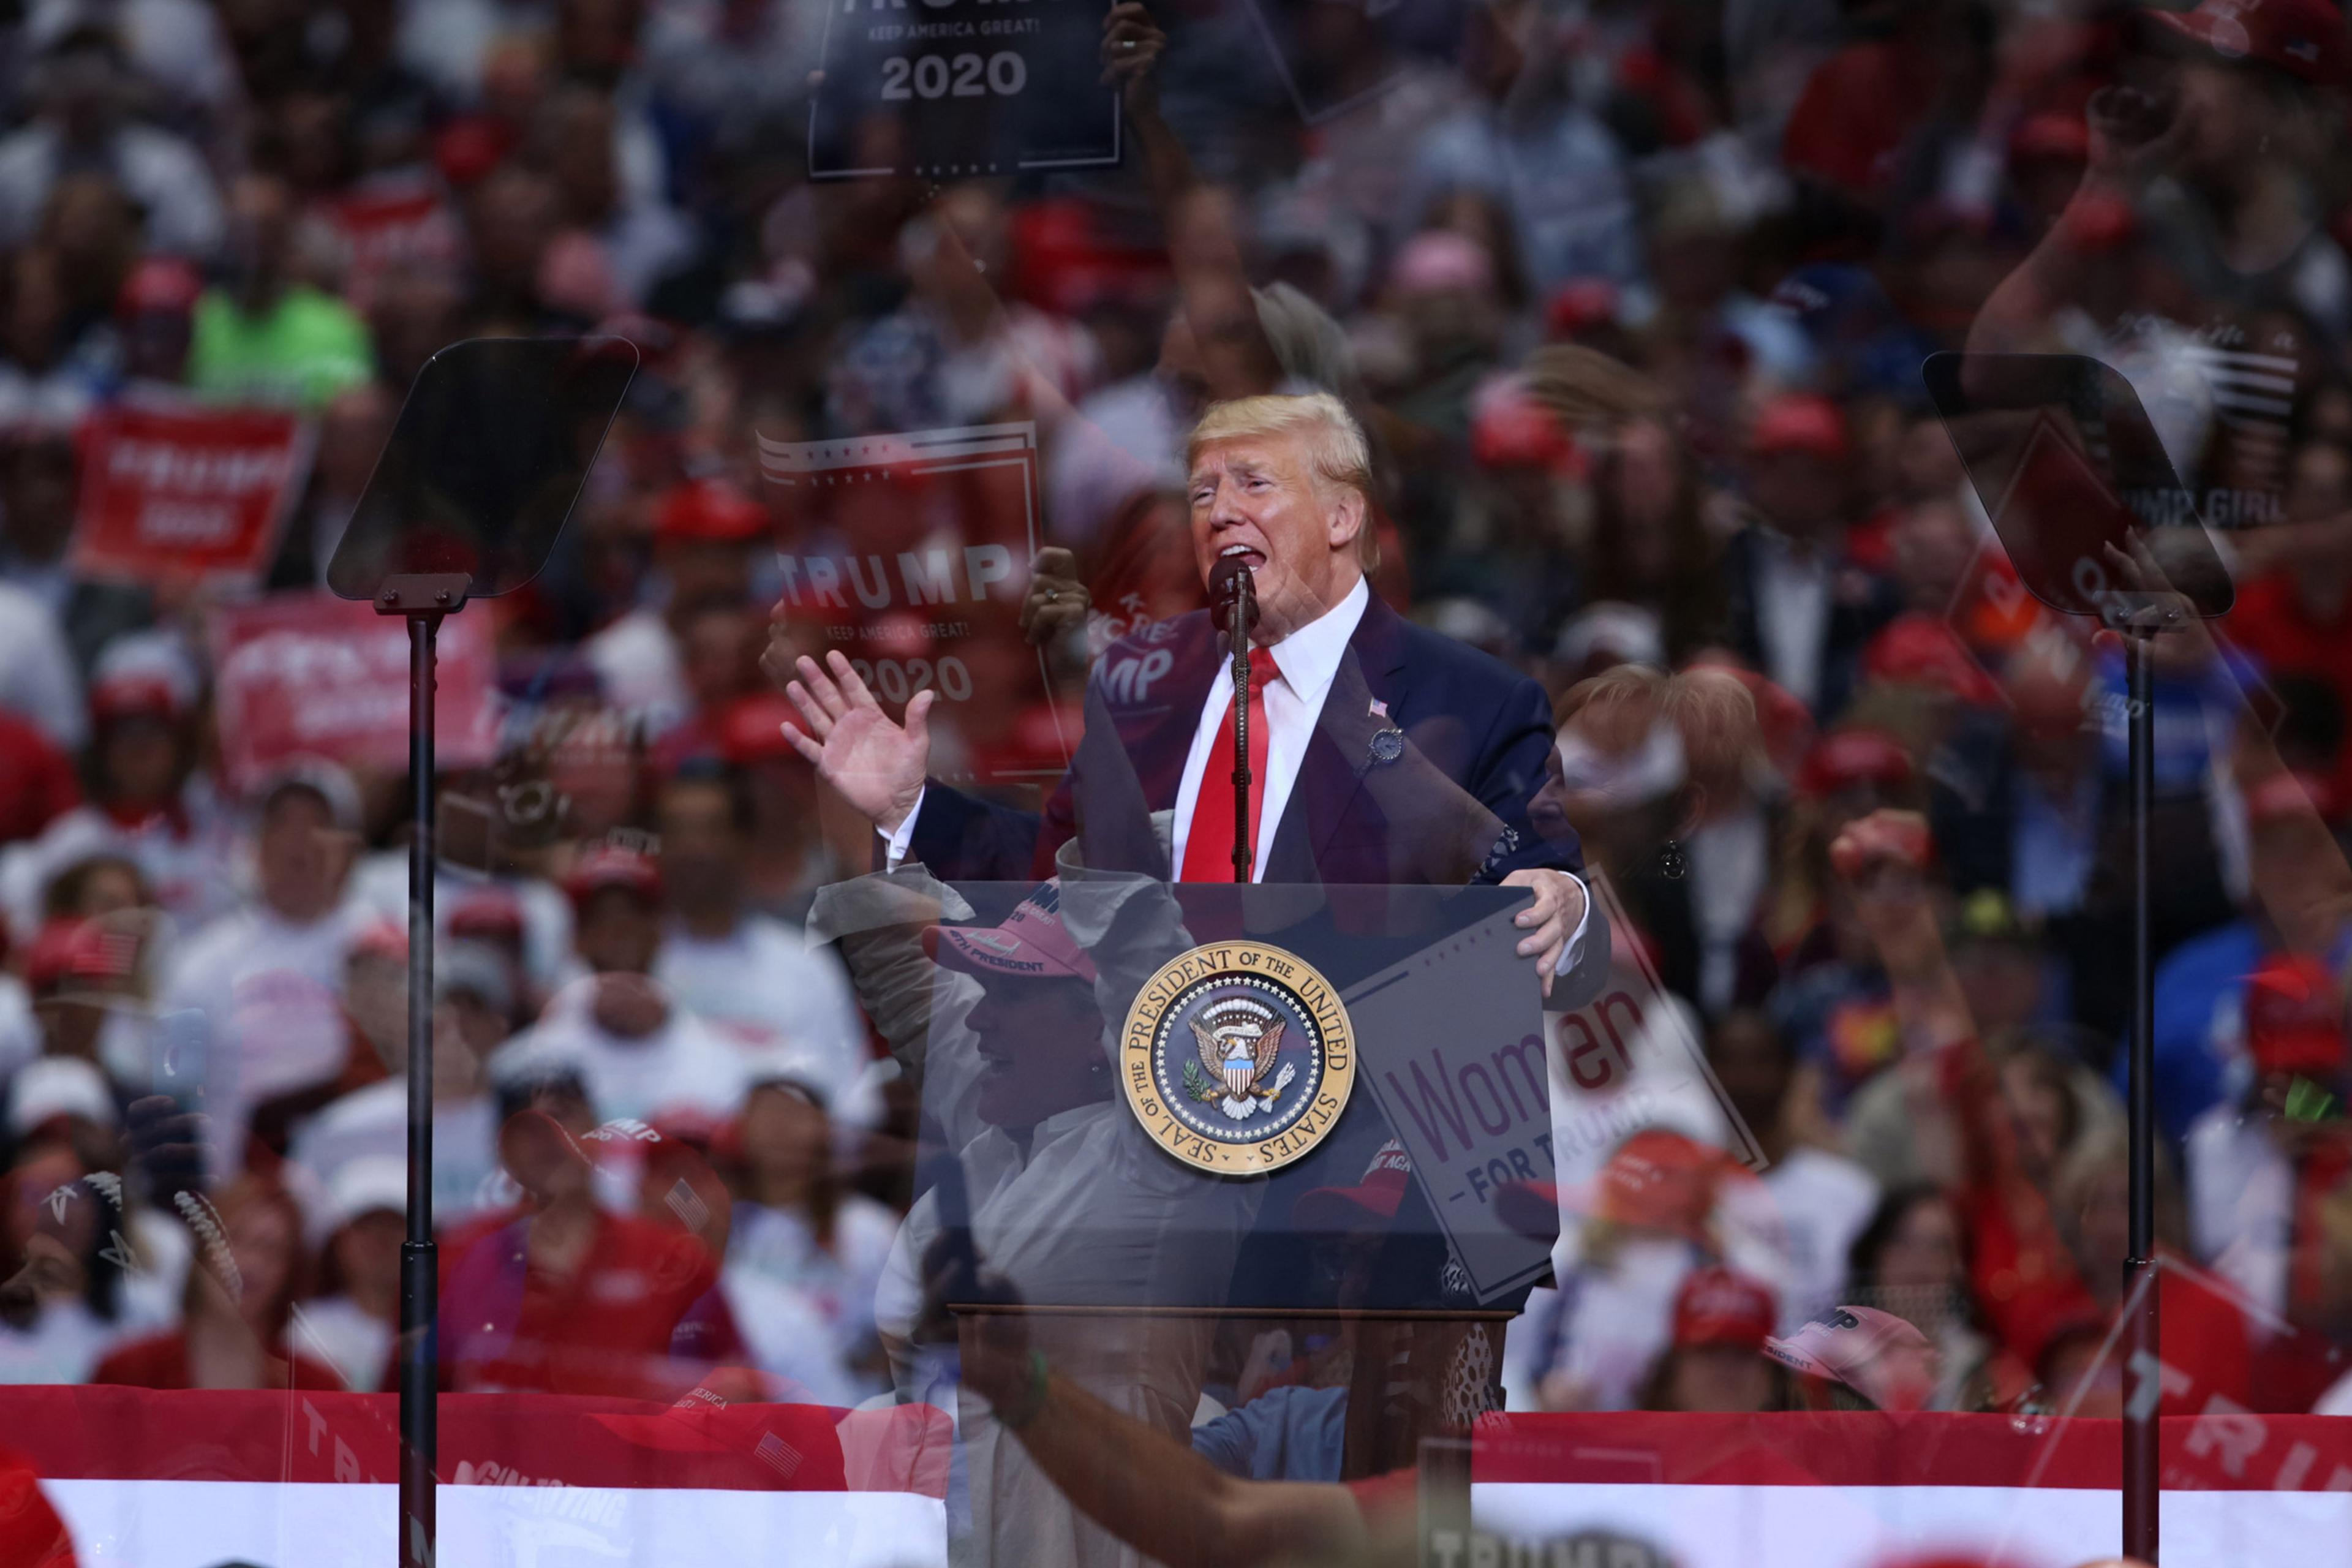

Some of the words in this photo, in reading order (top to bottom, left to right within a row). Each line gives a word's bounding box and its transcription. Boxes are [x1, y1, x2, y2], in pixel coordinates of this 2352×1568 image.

[867, 23, 905, 41] KEEP
[907, 19, 975, 39] AMERICA
[980, 17, 1041, 35] GREAT!
[881, 51, 1028, 100] 2020
[2206, 487, 2289, 529] GIRL
[775, 543, 1011, 610] TRUMP
[824, 626, 854, 641] KEEP
[859, 624, 915, 641] AMERICA
[920, 621, 971, 639] GREAT!
[850, 656, 973, 704] 2020
[970, 948, 1044, 972] PRESIDENT
[1239, 951, 1261, 966] OF
[1265, 956, 1295, 979] THE
[1128, 949, 1232, 1052] PRESIDENT
[1300, 976, 1348, 1071] UNITED
[1131, 1060, 1148, 1093] THE
[1384, 990, 1644, 1164] Women
[1140, 1097, 1159, 1117] OF
[1259, 1092, 1338, 1163] STATES
[1158, 1119, 1218, 1163] SEAL
